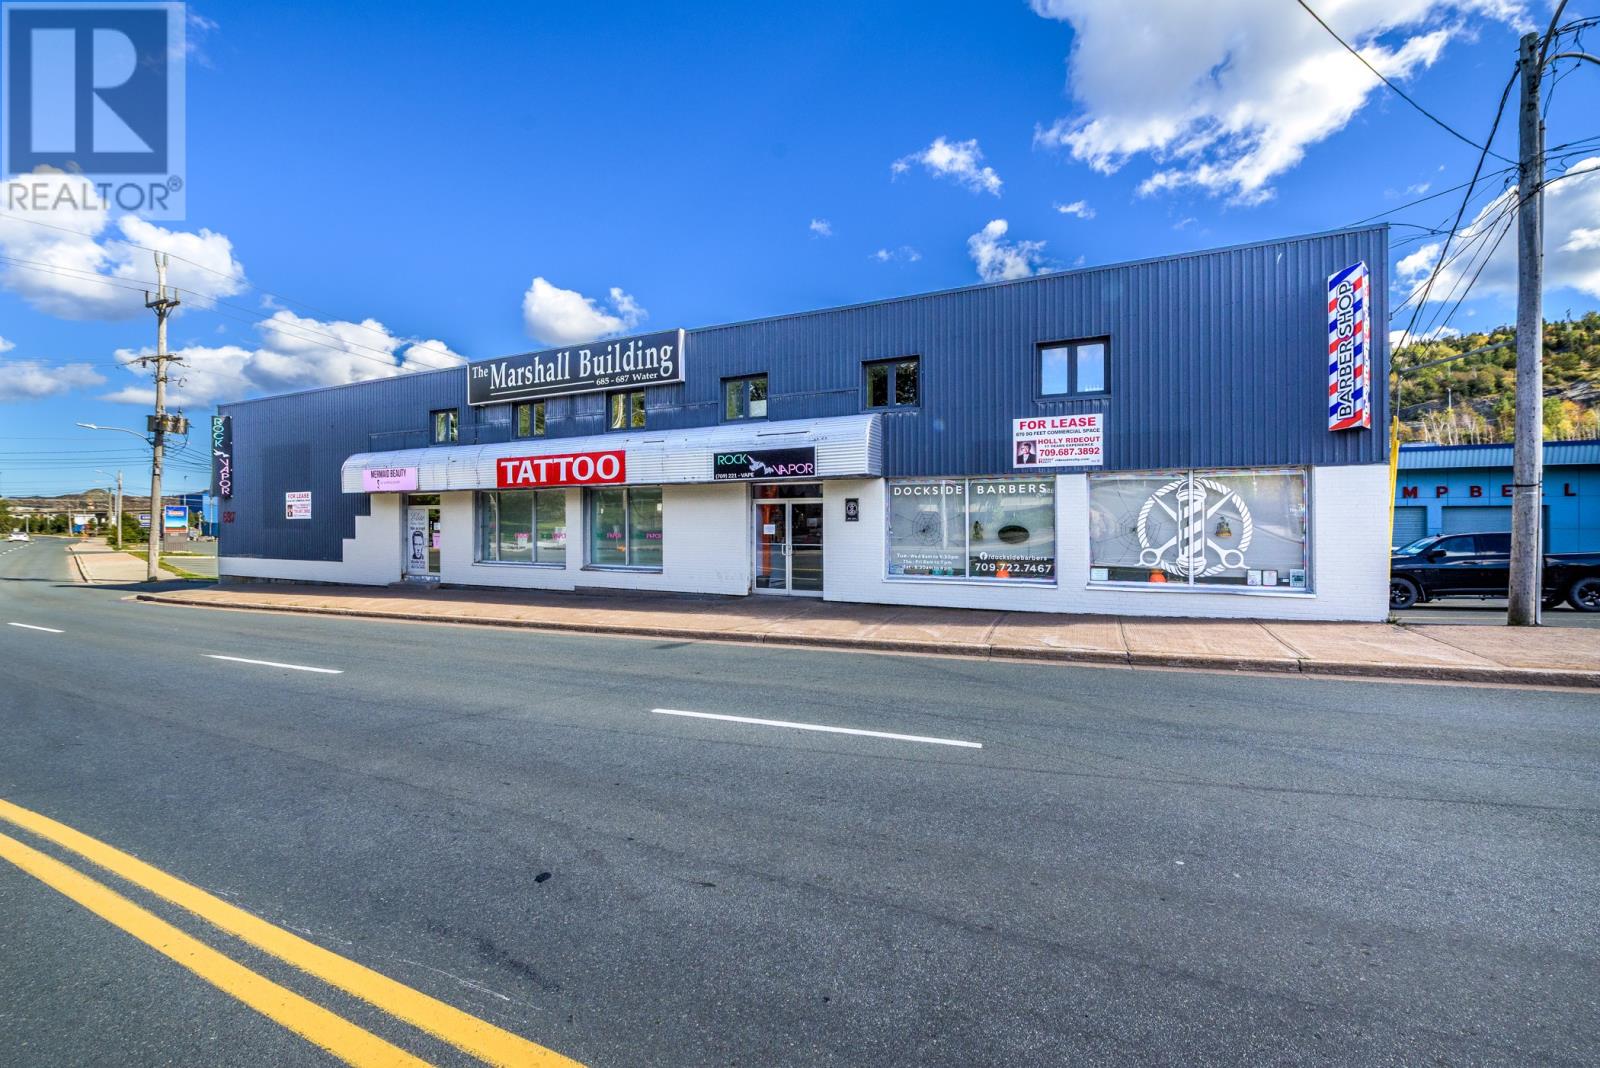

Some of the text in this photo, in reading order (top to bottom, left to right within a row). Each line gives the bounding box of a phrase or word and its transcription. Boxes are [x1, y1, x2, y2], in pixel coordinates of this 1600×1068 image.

[1337, 281, 1354, 418] BARBER SHOP
[472, 339, 673, 389] The Marshall Building
[596, 376, 610, 386] 685
[615, 374, 630, 384] 687
[632, 371, 658, 382] Water
[1019, 416, 1096, 430] FOR LEASE
[212, 417, 225, 447] ROCK
[1038, 437, 1063, 445] HOLLY
[1039, 447, 1100, 456] 709.687.3892
[717, 453, 747, 465] ROCK
[370, 468, 407, 479] MERMAID BEAUTY
[500, 454, 620, 484] TATTOO
[741, 471, 754, 479] VAPE
[772, 462, 814, 475] VAPOR
[219, 458, 231, 495] VAPOR
[893, 485, 963, 496] DOCKSIDE
[977, 483, 1047, 494] BARBERS
[1402, 483, 1577, 499] MPBEL
[974, 562, 1052, 573] 709.722.7467
